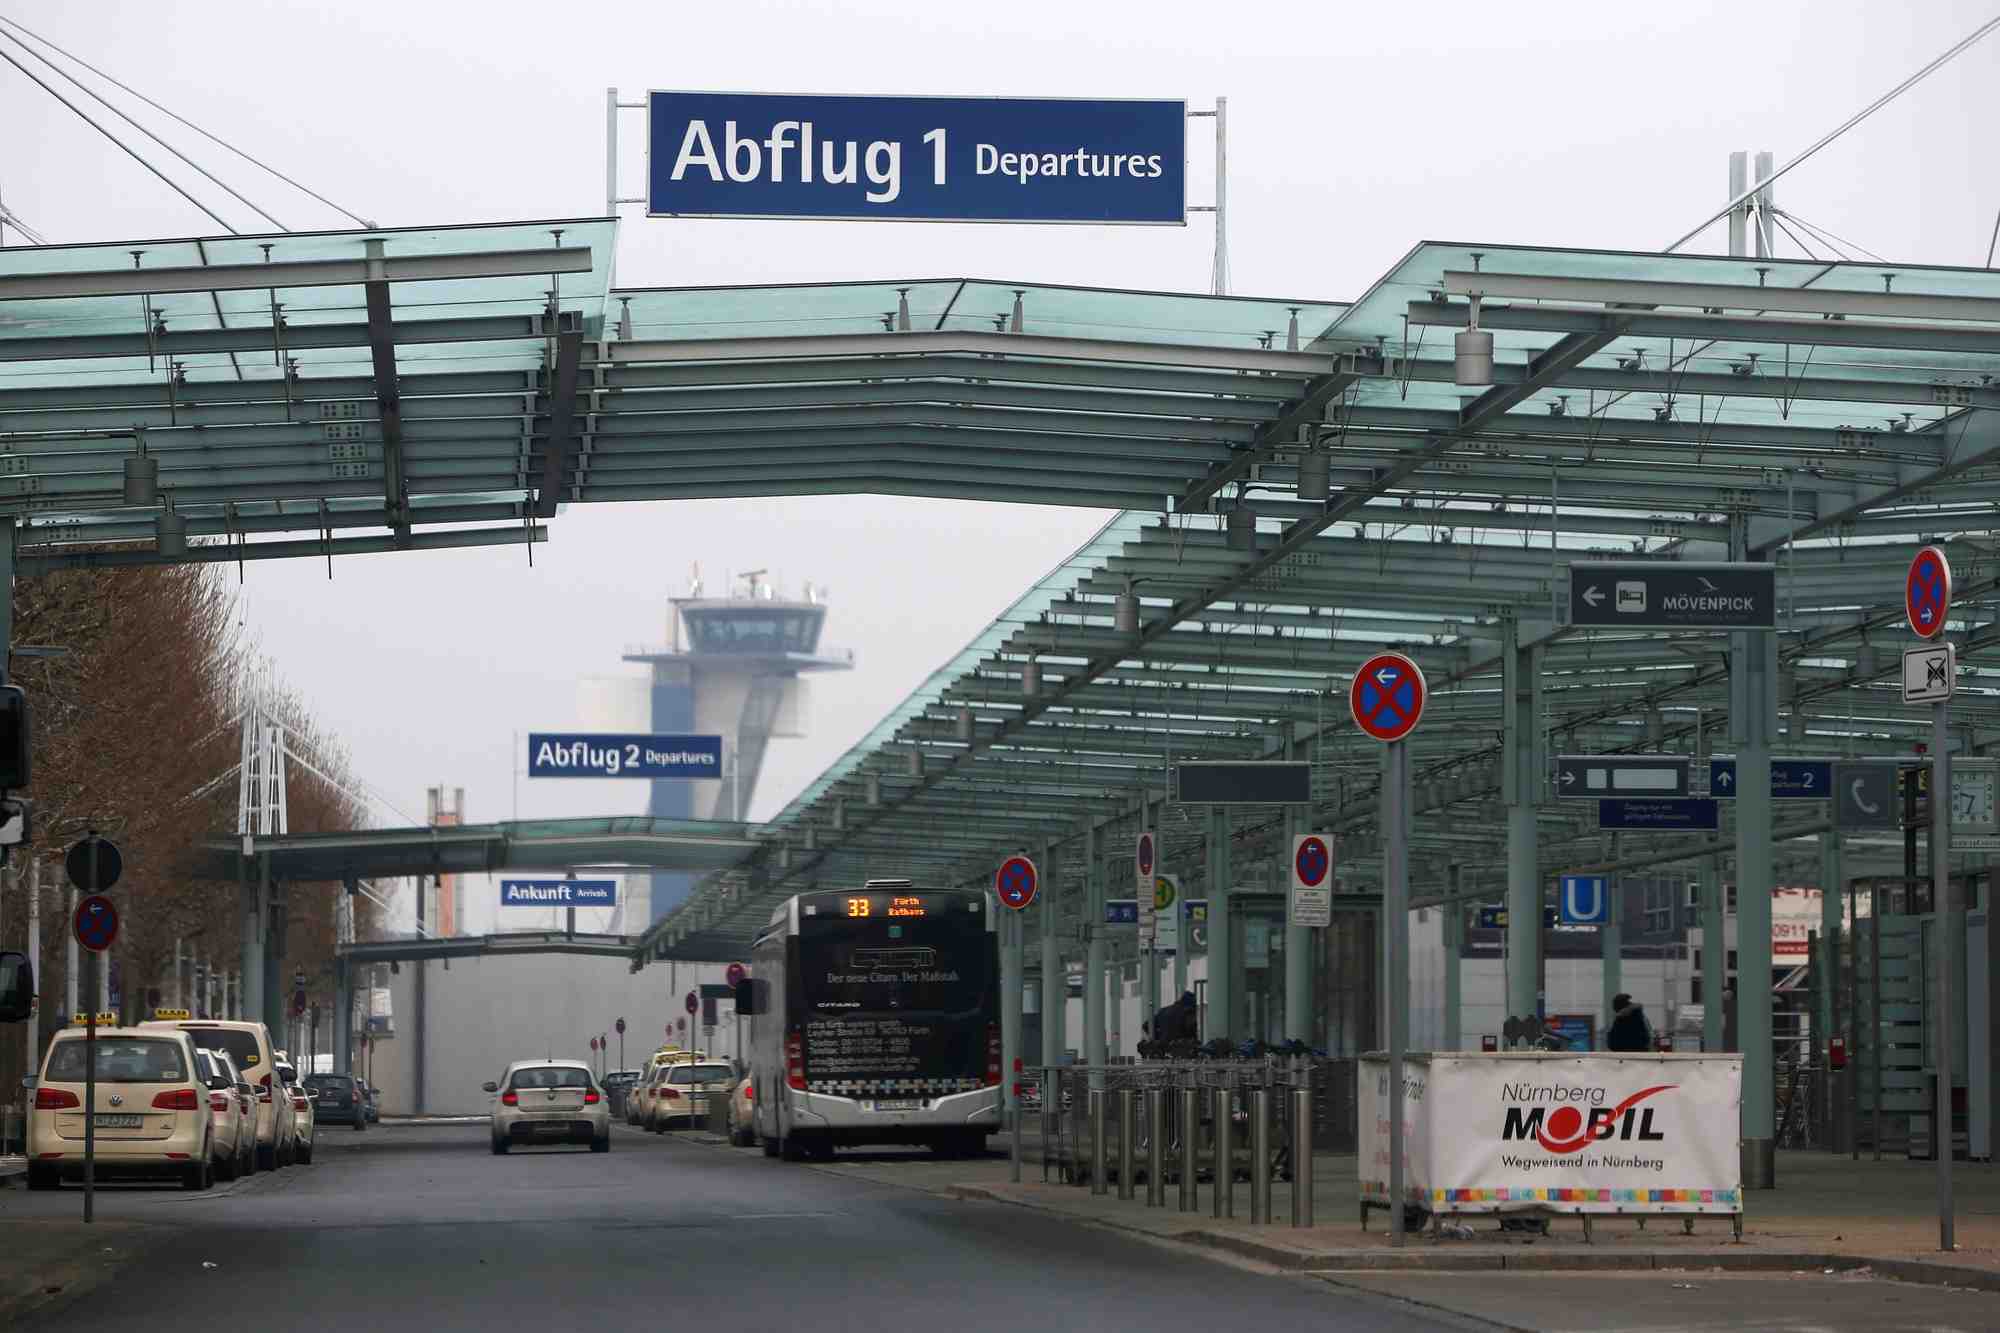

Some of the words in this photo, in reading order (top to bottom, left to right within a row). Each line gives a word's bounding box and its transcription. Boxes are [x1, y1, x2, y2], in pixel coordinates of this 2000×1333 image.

[671, 119, 901, 202] Abflug
[923, 128, 946, 185] 1
[976, 143, 1162, 184] Departures
[1663, 593, 1753, 611] MÖVENPICK
[535, 742, 620, 774] Abflug
[624, 744, 640, 768] 2
[645, 749, 715, 767] Departures
[1801, 772, 1815, 788] 2
[507, 884, 571, 900] Ankunft
[577, 889, 608, 898] Arrivals
[1567, 879, 1601, 920] U
[847, 898, 870, 917] 33
[1502, 1084, 1606, 1105] Nürnberg
[1502, 1107, 1664, 1142] MOBIL
[1502, 1155, 1583, 1171] Wegweisend
[1587, 1156, 1598, 1167] in
[1602, 1155, 1664, 1171] Nürnberg
